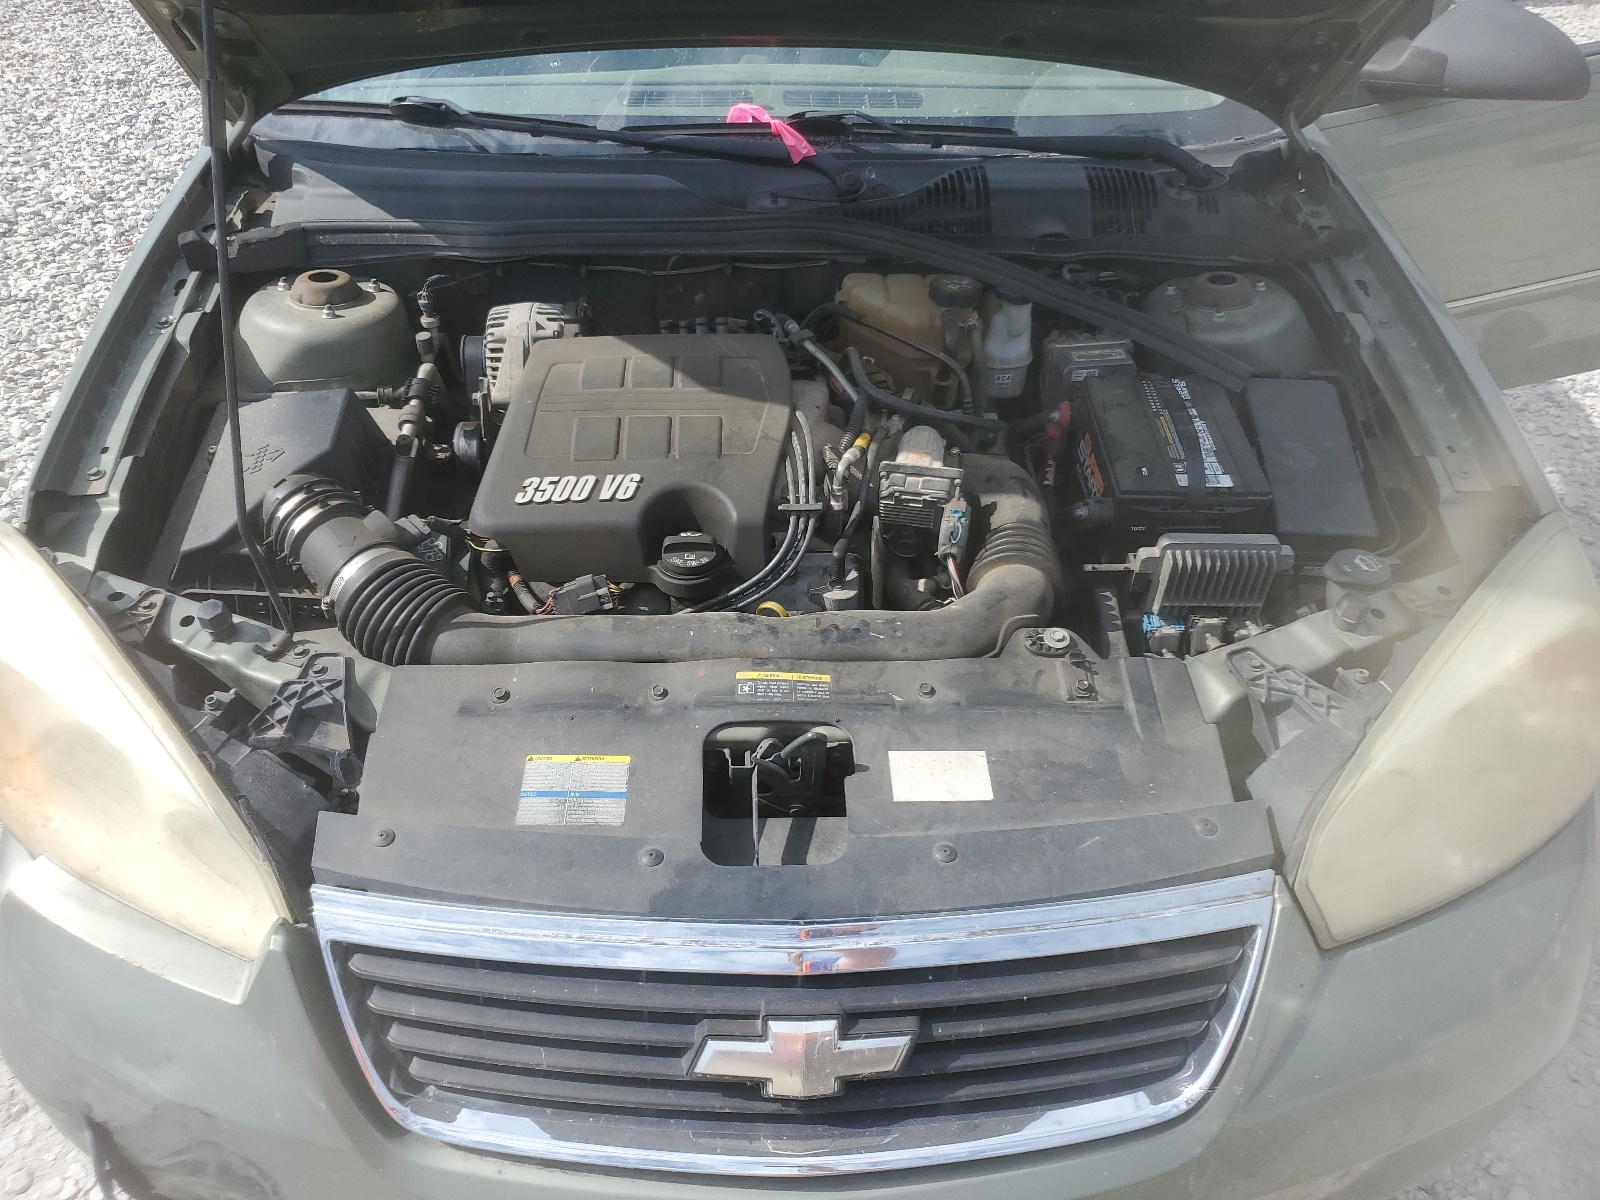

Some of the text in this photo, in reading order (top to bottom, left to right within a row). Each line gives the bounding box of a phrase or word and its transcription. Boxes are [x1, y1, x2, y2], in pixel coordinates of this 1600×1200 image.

[514, 473, 643, 504] 3500 V6
[670, 556, 709, 567] SAE 5W-30
